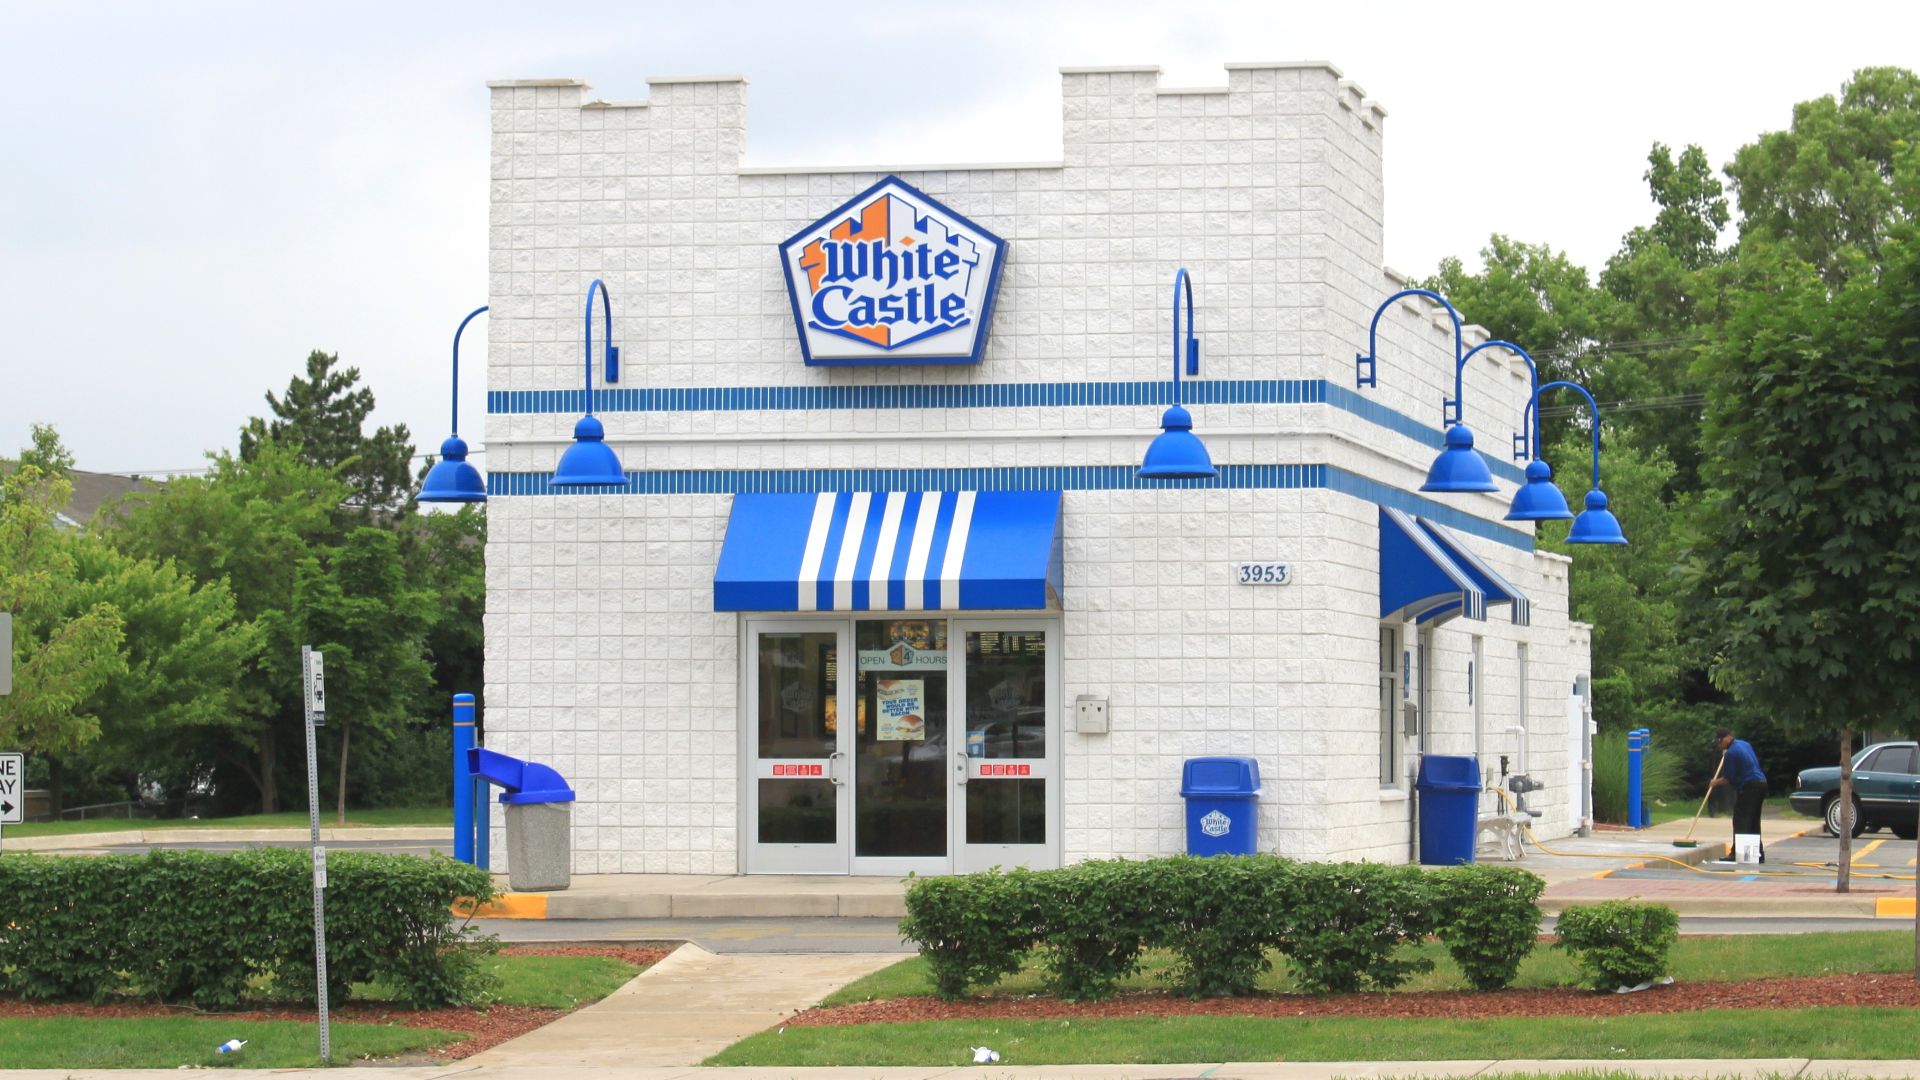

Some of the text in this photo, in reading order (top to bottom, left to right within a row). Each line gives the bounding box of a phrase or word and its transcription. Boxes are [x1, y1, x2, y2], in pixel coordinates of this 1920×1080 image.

[821, 240, 960, 289] White
[811, 283, 966, 324] Castle
[1240, 564, 1286, 583] 3953
[860, 656, 885, 665] OPEN
[915, 656, 948, 665] HOURS
[0, 760, 16, 775] NE
[0, 779, 16, 794] AY
[1204, 824, 1228, 834] Castle
[1206, 818, 1227, 828] White
